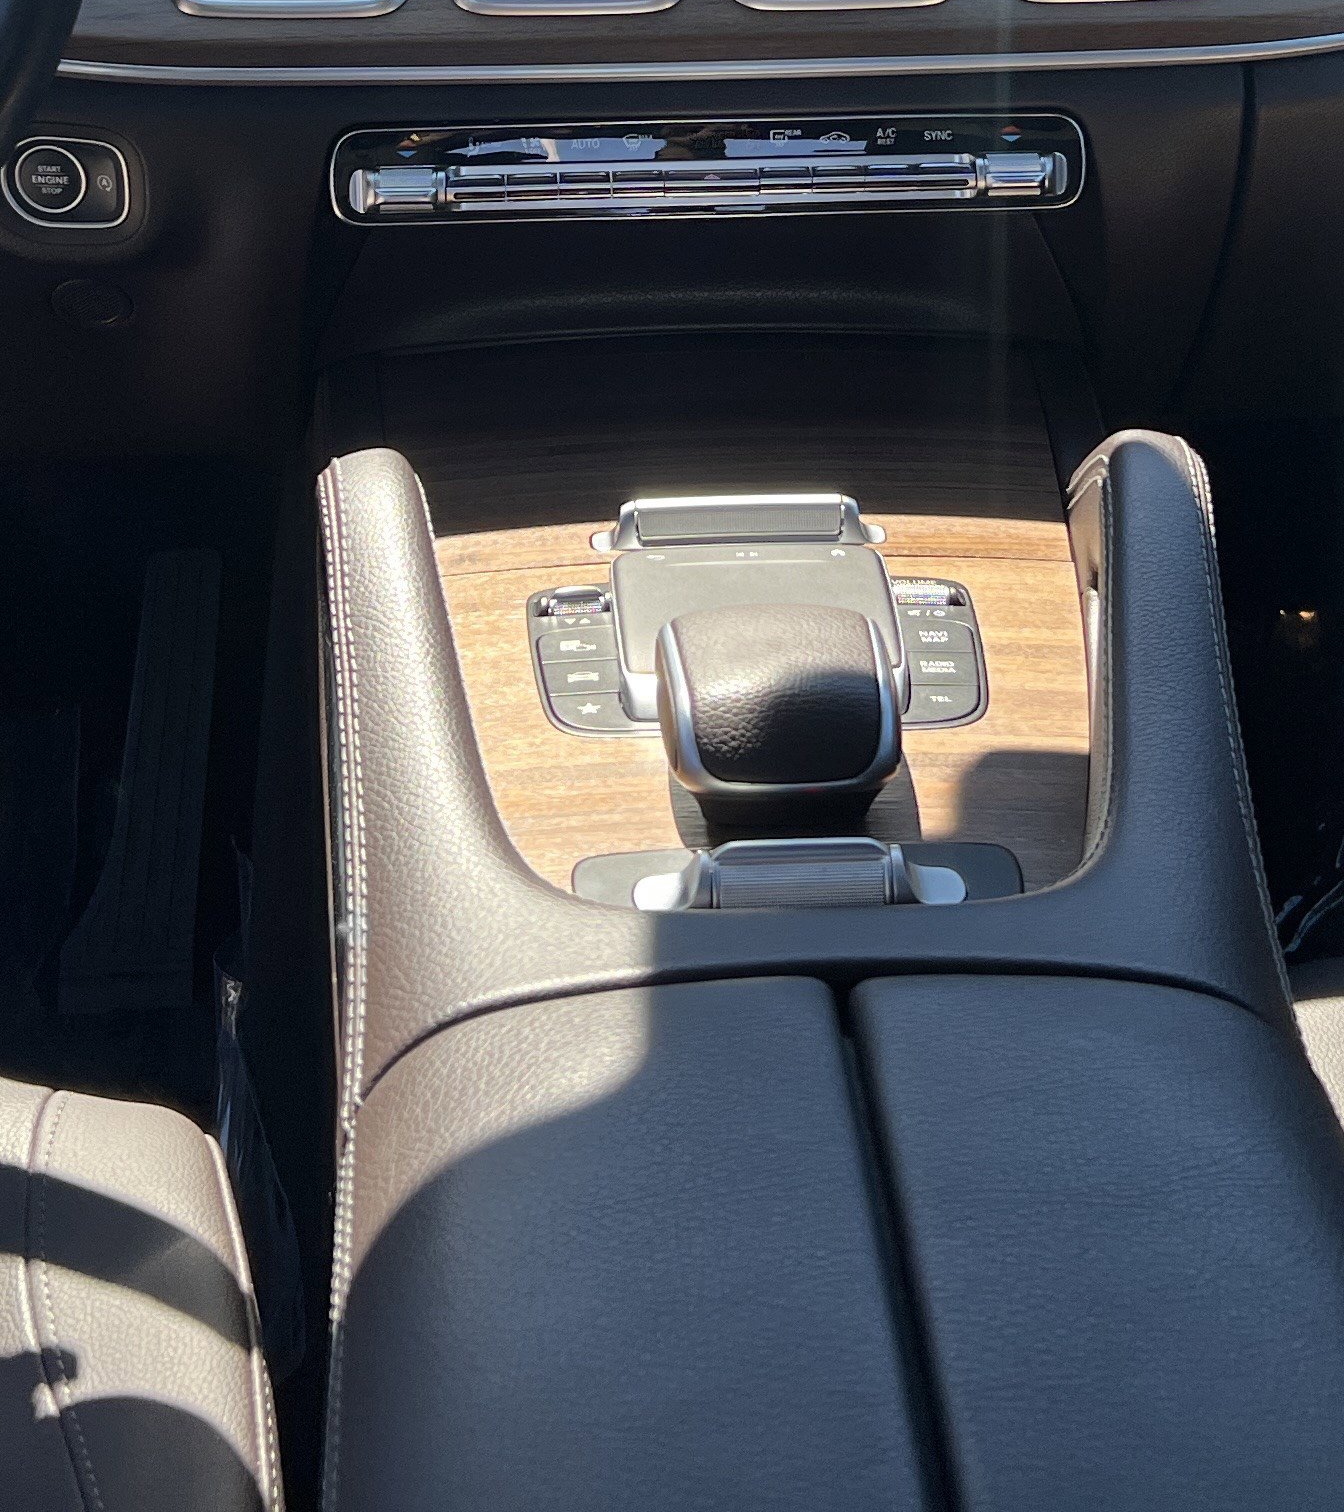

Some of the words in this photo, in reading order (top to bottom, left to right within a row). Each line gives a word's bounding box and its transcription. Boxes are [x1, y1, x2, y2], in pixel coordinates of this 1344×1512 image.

[876, 127, 897, 138] A/C
[924, 129, 953, 141] SYNC
[570, 138, 600, 150] AUTO
[37, 165, 61, 173] START
[31, 174, 70, 185] ENGINE
[41, 187, 63, 195] STOP
[929, 695, 953, 703] TEL
